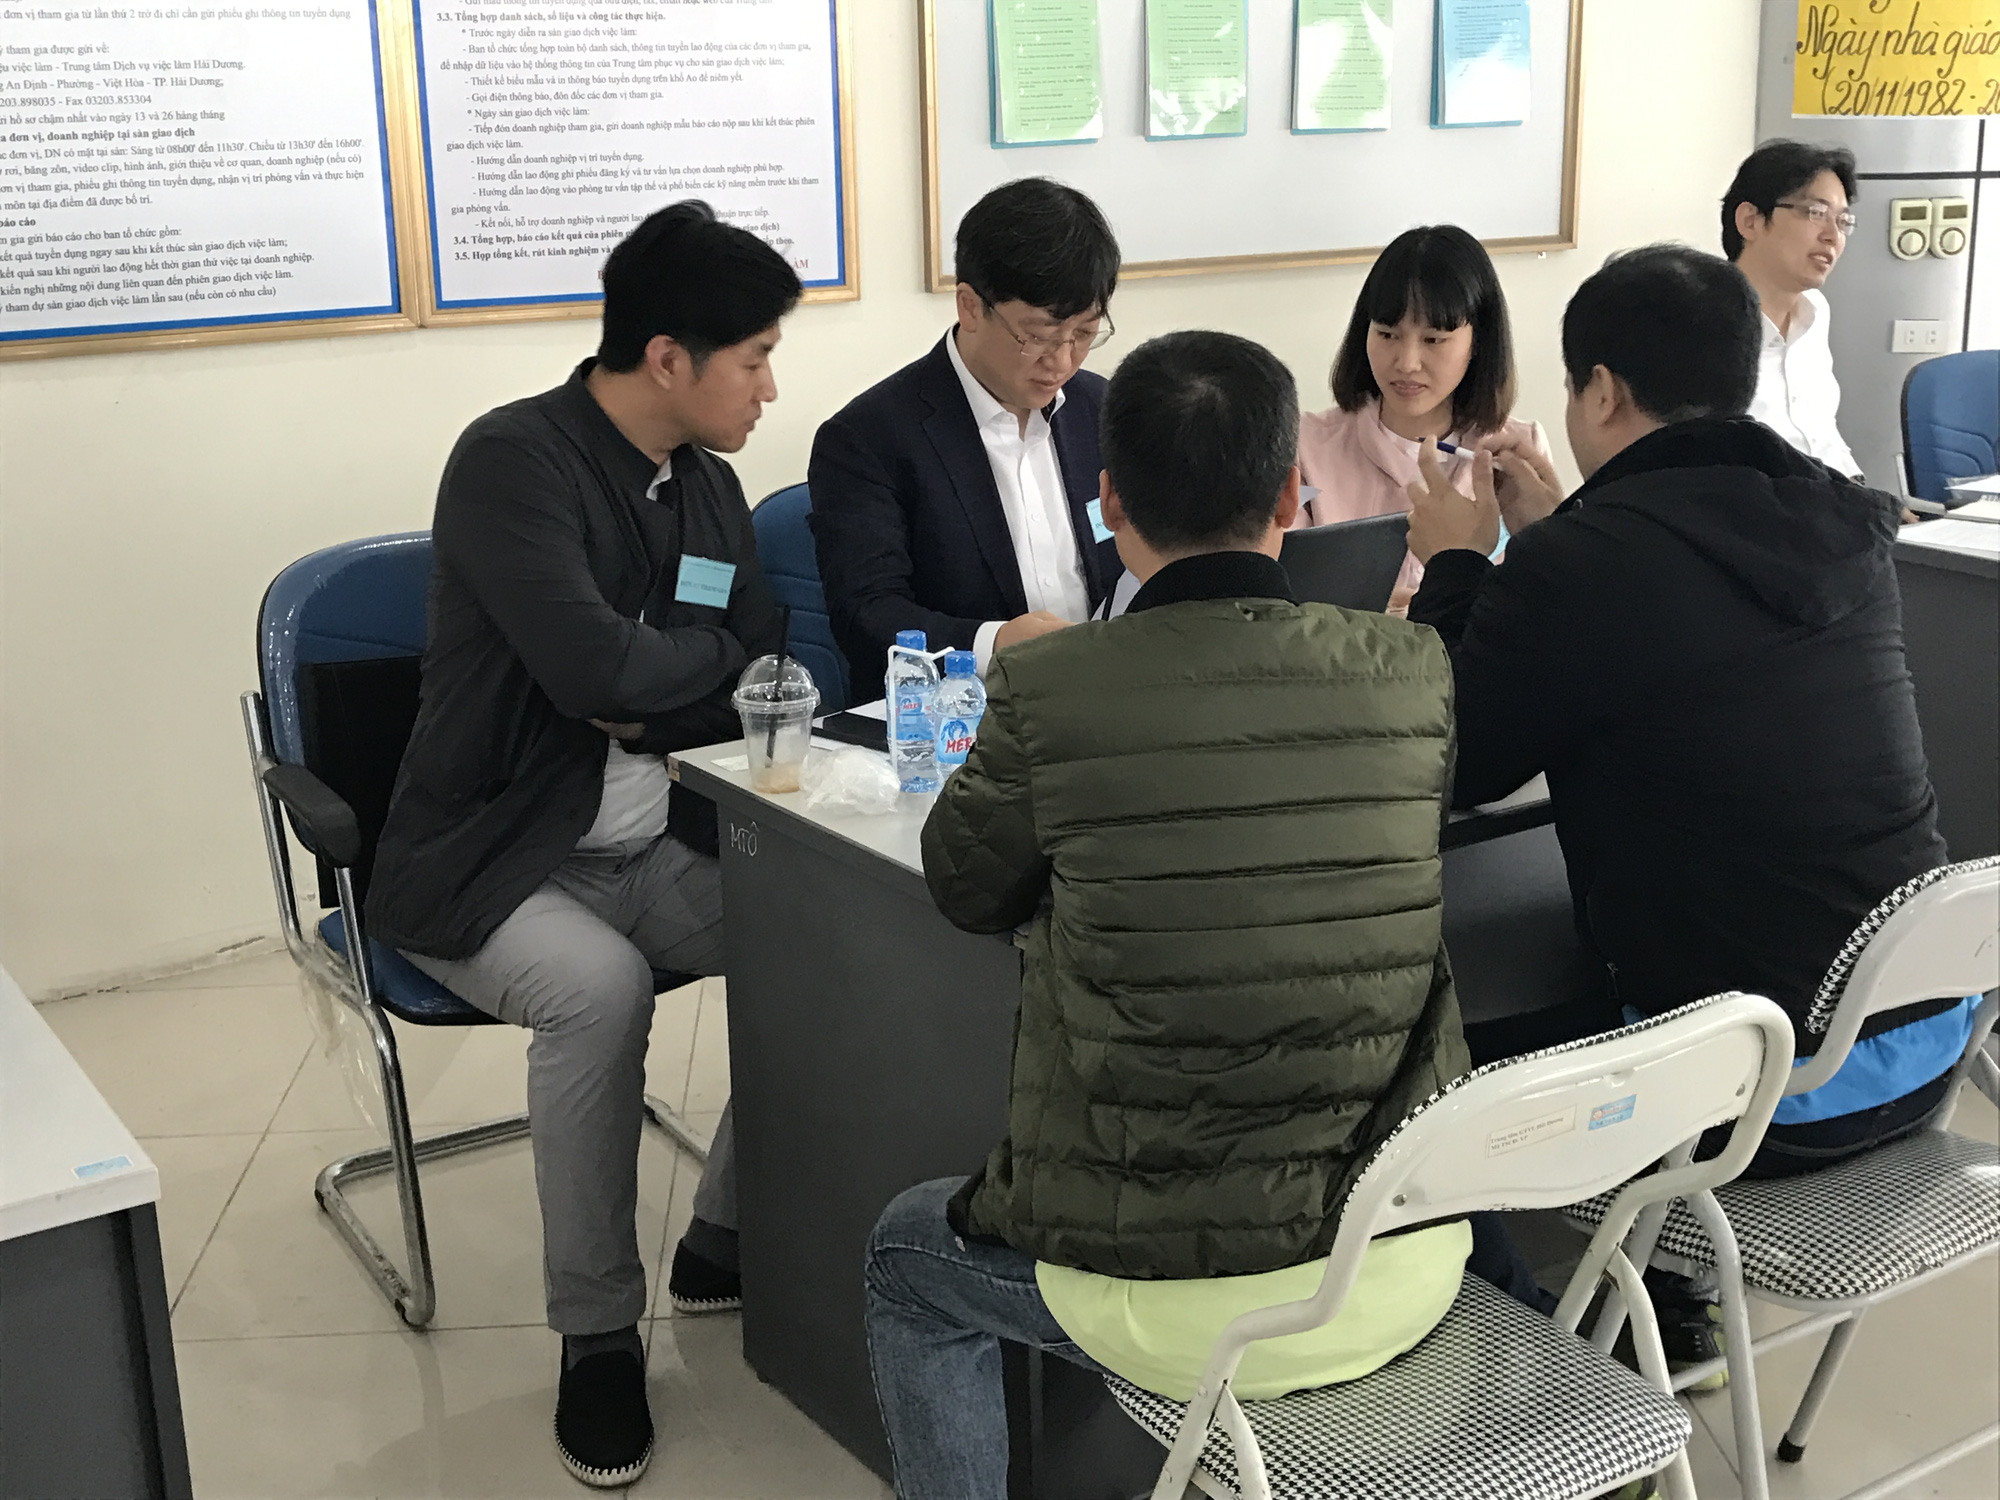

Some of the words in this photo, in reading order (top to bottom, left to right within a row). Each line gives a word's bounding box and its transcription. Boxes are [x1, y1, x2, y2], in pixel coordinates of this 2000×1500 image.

[1796, 4, 1879, 82] Ngày
[1882, 2, 1939, 56] nhà
[1937, 20, 2000, 79] giáo
[65, 95, 83, 106] Fax
[85, 94, 152, 105] 03203.853304
[9, 132, 29, 142] đơn
[47, 130, 78, 140] doanh
[81, 129, 114, 141] nghiệp
[117, 129, 130, 141] tại
[132, 128, 149, 138] sàn
[151, 127, 172, 139] giao
[174, 127, 195, 139] dịch
[9, 148, 28, 159] đơn
[44, 147, 61, 158] DN
[63, 147, 75, 157] có
[76, 146, 94, 158] mặt
[96, 146, 108, 158] tại
[130, 144, 153, 157] Sáng
[155, 144, 164, 154] từ
[276, 140, 285, 150] từ
[4, 165, 22, 177] rơi,
[23, 164, 48, 177] băng
[72, 162, 99, 173] video
[101, 161, 122, 174] clip,
[123, 161, 144, 171] hình
[168, 159, 186, 171] giới
[188, 158, 212, 170] thiệu
[240, 159, 264, 169] quan,
[266, 155, 293, 165] doanh
[295, 154, 324, 166] nghiệp
[63, 248, 88, 260] dụng
[89, 249, 112, 259] ngay
[132, 244, 147, 254] khi
[149, 242, 164, 253] kết
[166, 242, 185, 252] thúc
[188, 241, 203, 251] sàn
[205, 240, 224, 253] giao
[226, 239, 246, 251] dịch
[247, 238, 266, 250] việc
[55, 265, 70, 275] khi
[73, 264, 100, 276] người
[103, 262, 117, 273] lao
[119, 261, 143, 274] động
[144, 258, 159, 270] hết
[161, 259, 179, 269] thời
[181, 258, 201, 271] gian
[220, 255, 238, 267] việc
[240, 255, 252, 266] tại
[253, 253, 280, 263] doanh
[23, 284, 45, 296] nghị
[47, 282, 78, 295] những
[79, 281, 94, 292] nội
[96, 279, 120, 292] dung
[122, 278, 140, 288] liên
[141, 279, 164, 289] quan
[185, 274, 210, 286] phiên
[212, 272, 231, 285] giao
[233, 271, 252, 283] dịch
[254, 270, 273, 282] việc
[945, 737, 972, 753] MER
